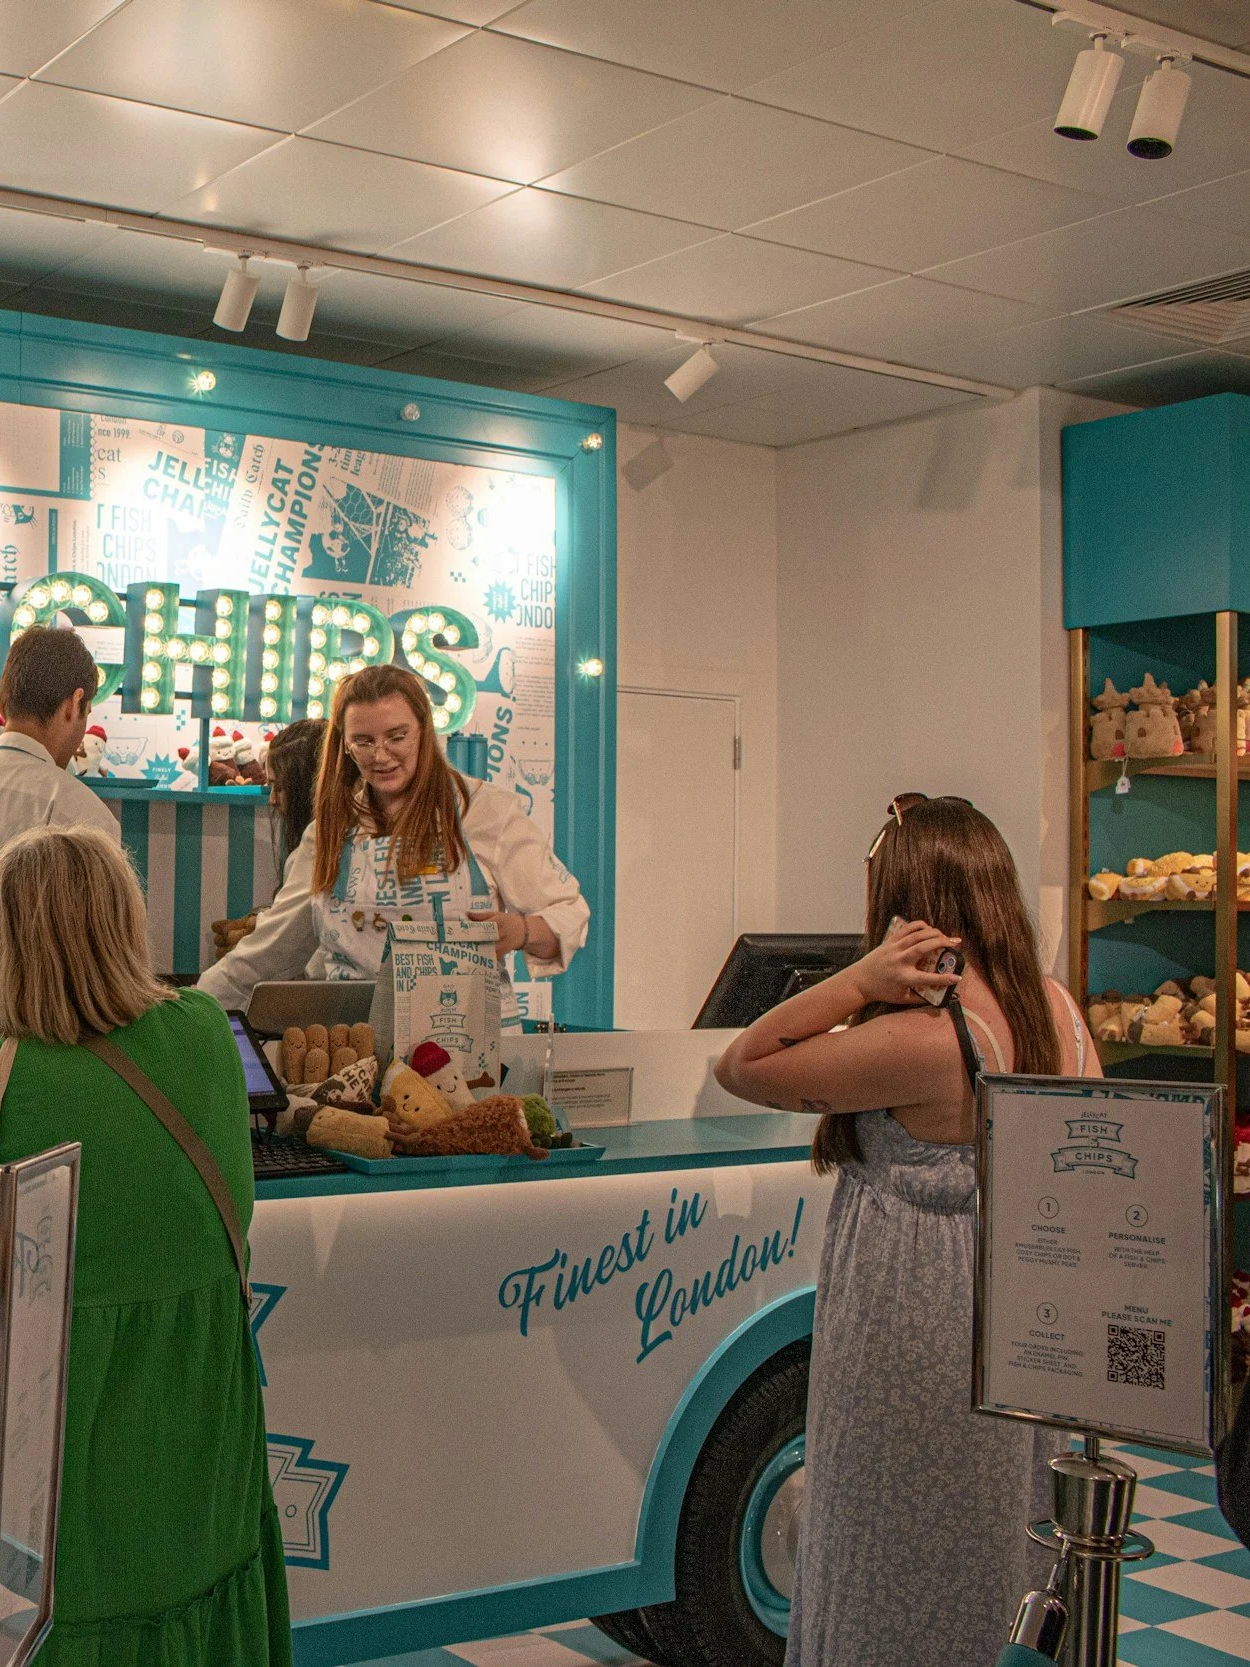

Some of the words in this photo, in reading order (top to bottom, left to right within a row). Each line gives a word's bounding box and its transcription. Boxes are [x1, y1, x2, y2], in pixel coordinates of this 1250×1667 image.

[96, 447, 122, 463] cat
[245, 444, 264, 483] Catch
[111, 505, 151, 533] FISH
[249, 457, 294, 595] JELLYCAT
[103, 533, 157, 563] CHIPS
[520, 578, 557, 603] CHIP
[394, 954, 414, 966] BEST
[417, 953, 435, 966] FISH
[426, 941, 494, 970] CHAMPIONS
[396, 967, 411, 979] AND
[415, 966, 438, 976] CHIPS
[396, 980, 404, 992] IN
[1080, 1111, 1108, 1119] JELLYCAT
[1080, 1125, 1108, 1135] FISH
[1075, 1152, 1113, 1163] CHIPS
[1046, 1202, 1051, 1212] 1
[1133, 1211, 1140, 1221] 2
[1031, 1224, 1066, 1234] CHOOSE
[1108, 1231, 1166, 1245] PERSONALISE
[498, 1208, 655, 1337] Finest
[664, 1187, 707, 1245] in
[1124, 1261, 1148, 1269] SERVER
[635, 1197, 805, 1364] London!
[1043, 1308, 1051, 1319] 3
[1124, 1305, 1149, 1313] MENU
[1102, 1311, 1134, 1321] PLEASE
[1134, 1315, 1158, 1325] SCAN
[1159, 1319, 1173, 1327] ME
[1029, 1329, 1065, 1341] COLLECT
